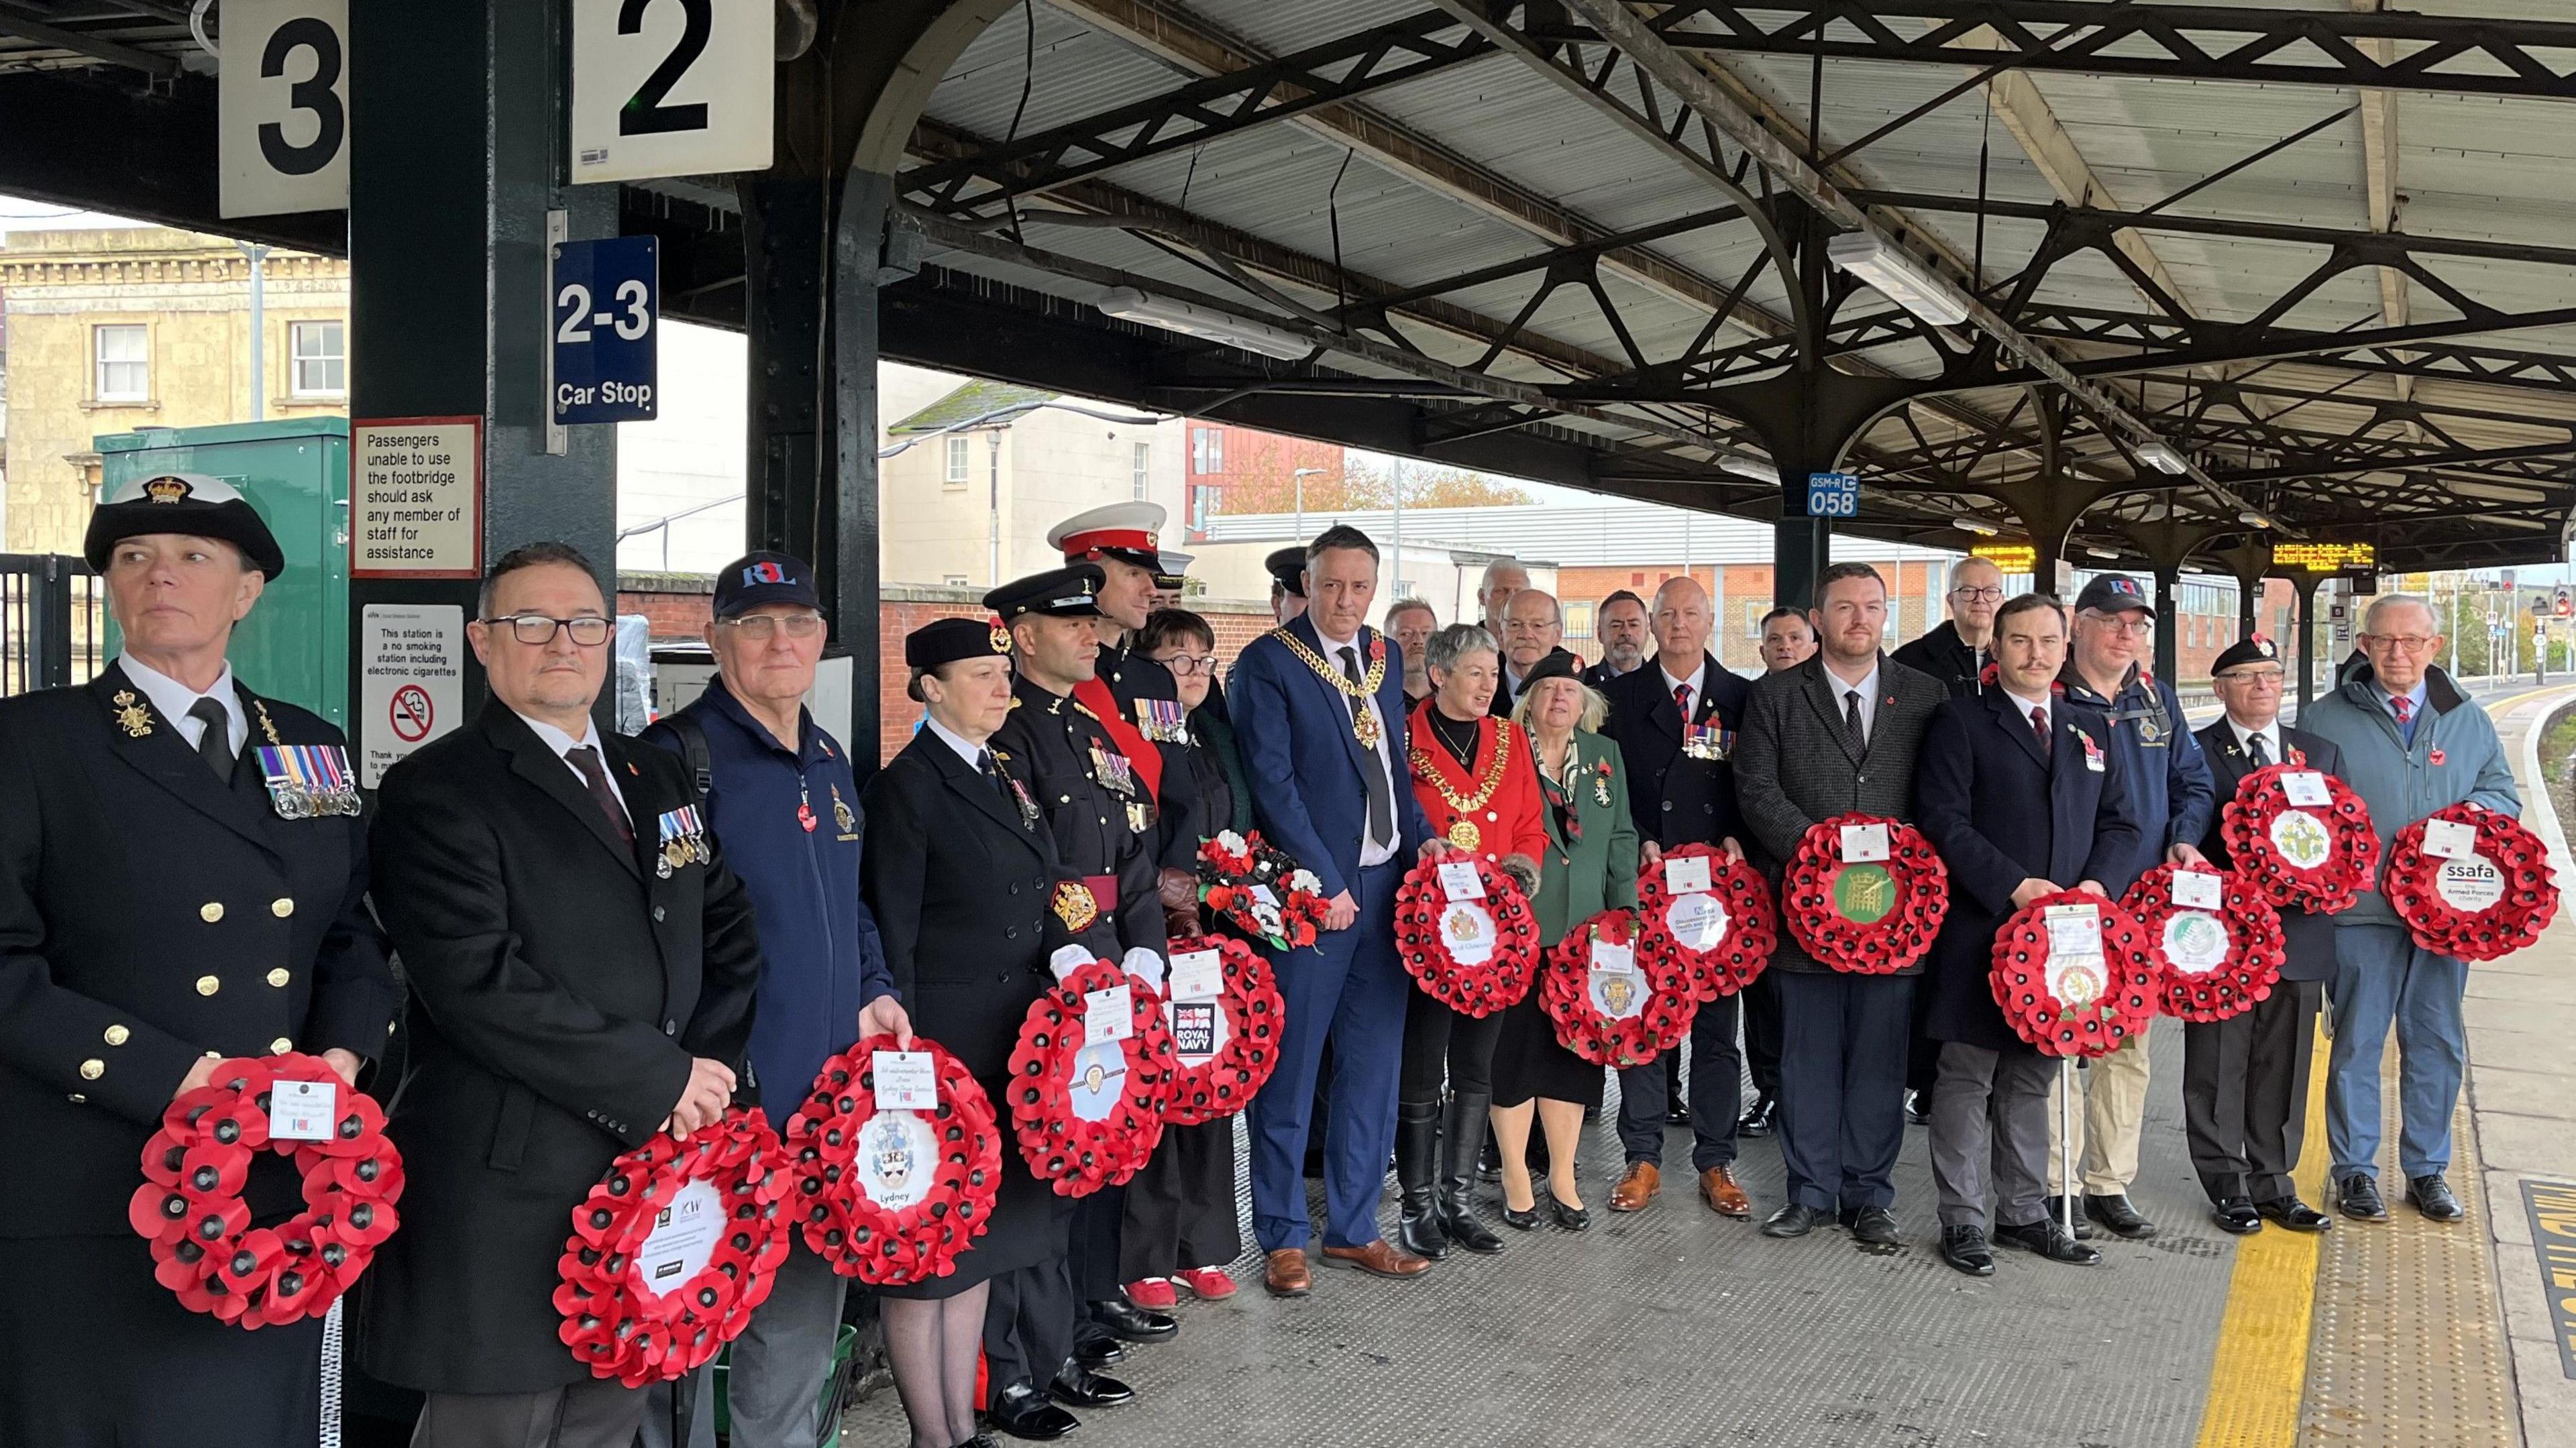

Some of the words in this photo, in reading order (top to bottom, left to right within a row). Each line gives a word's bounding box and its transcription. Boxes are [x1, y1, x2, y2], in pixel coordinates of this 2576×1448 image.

[617, 0, 712, 137] 2
[258, 17, 344, 175] 3
[557, 280, 649, 343] 2-3
[557, 383, 596, 405] Car
[602, 381, 651, 408] Stop
[368, 435, 439, 449] Passengers
[368, 453, 407, 465] unable
[413, 453, 424, 465] to
[429, 454, 451, 465] use
[368, 472, 387, 484] the
[392, 471, 455, 486] footbridge
[1811, 478, 1841, 488] GSM-R
[368, 490, 407, 503] should
[411, 490, 433, 502] ask
[1811, 491, 1854, 514] 058
[367, 510, 389, 524] any
[394, 508, 443, 521] member
[448, 508, 460, 520] of
[367, 526, 396, 540] staff
[401, 526, 419, 540] for
[367, 546, 434, 559] assistance
[381, 628, 398, 638] This
[402, 629, 432, 638] station
[435, 629, 443, 638] is
[407, 642, 441, 653] smoking
[377, 653, 406, 663] station
[410, 653, 447, 665] including
[368, 666, 409, 675] electronic
[413, 667, 457, 677] cigarettes
[129, 726, 152, 737] CIS
[370, 750, 392, 759] Thank
[370, 761, 378, 769] to
[2447, 864, 2494, 878] ssafa
[1177, 1030, 1210, 1040] ROYAL
[1177, 1039, 1210, 1050] NAVY
[880, 1192, 910, 1205] Lydney
